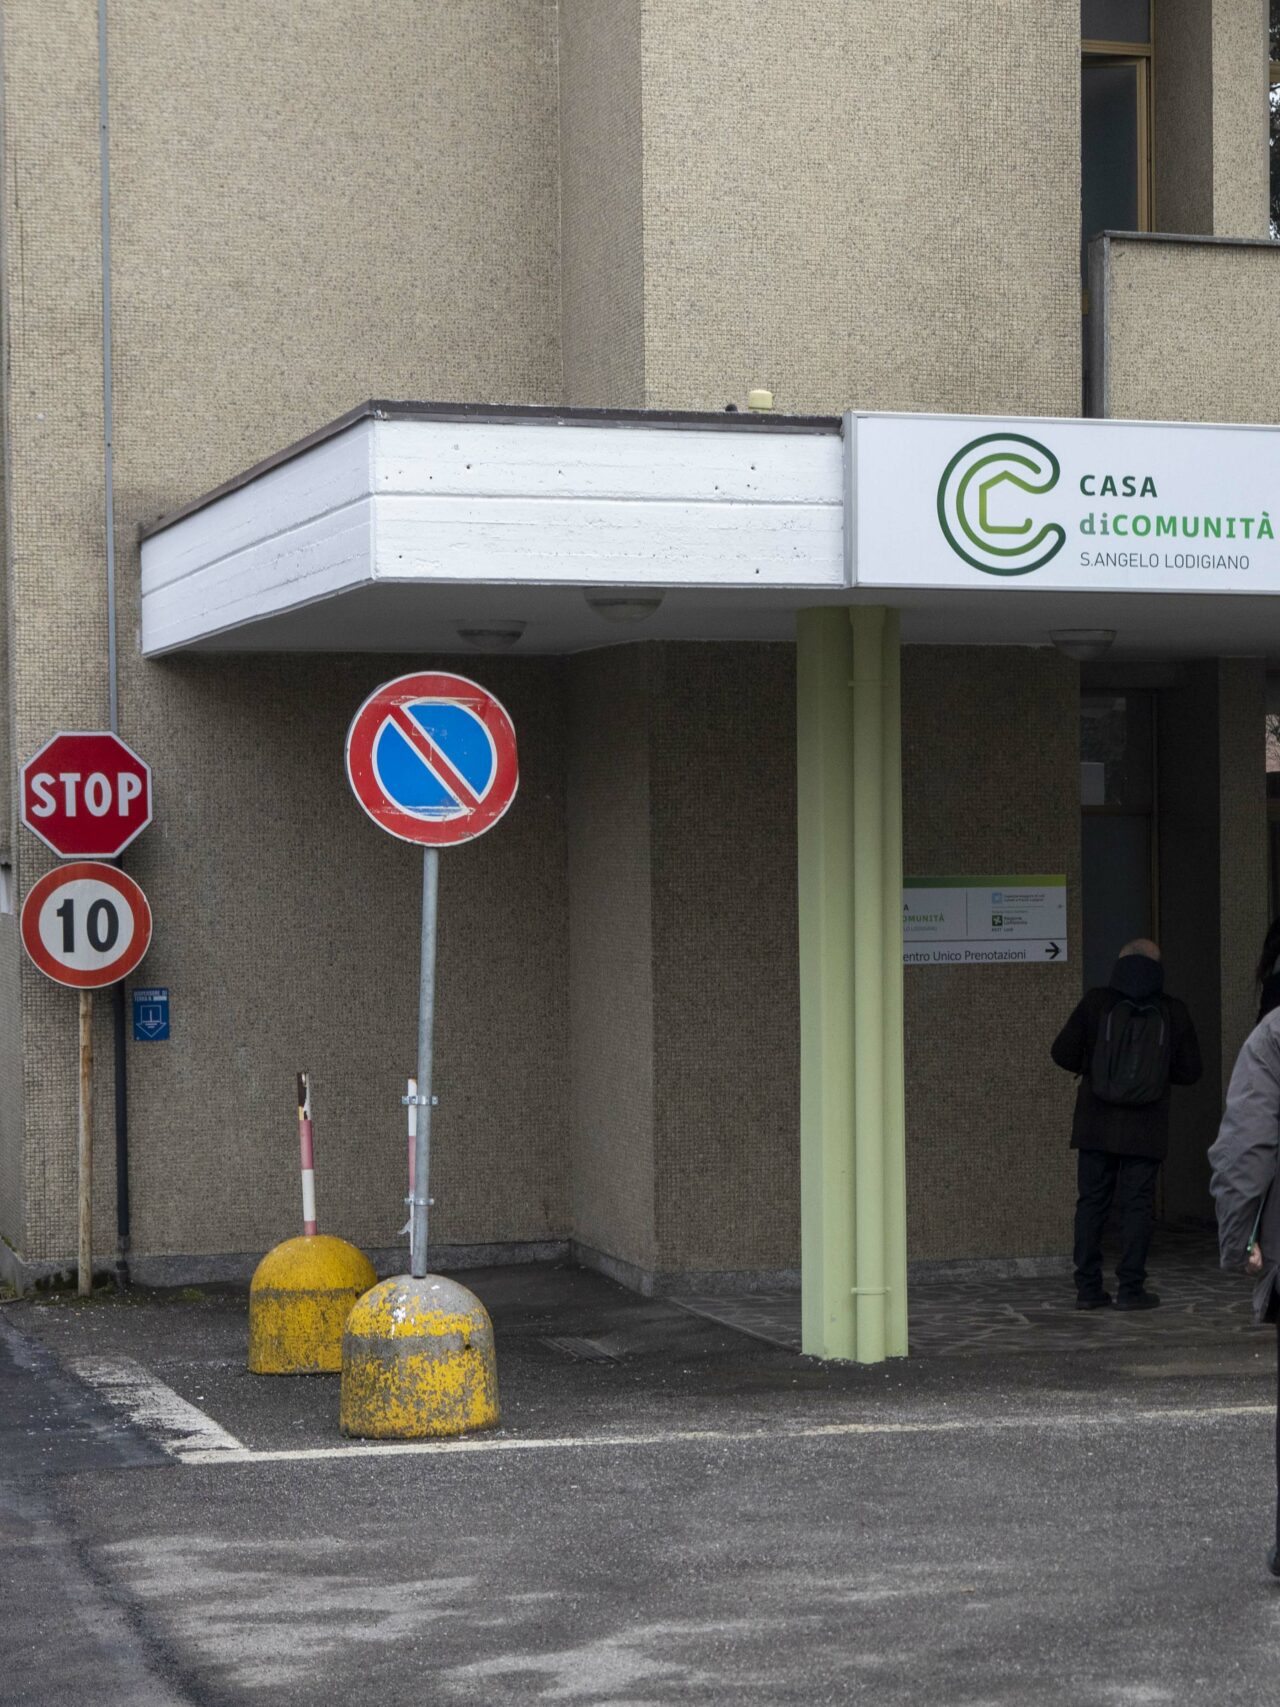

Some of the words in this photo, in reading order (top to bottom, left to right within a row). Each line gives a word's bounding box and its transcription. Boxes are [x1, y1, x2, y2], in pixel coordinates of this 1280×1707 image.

[1079, 475, 1158, 498] CASA
[1079, 511, 1275, 540] diCOMUNITÀ
[1080, 551, 1160, 569] S.ANGELO
[1165, 554, 1250, 570] LODIGIANO
[31, 772, 142, 818] STOP
[56, 898, 119, 953] 10
[903, 952, 930, 962] entro
[933, 951, 962, 961] Unico
[964, 949, 1026, 960] Prenotazioni
